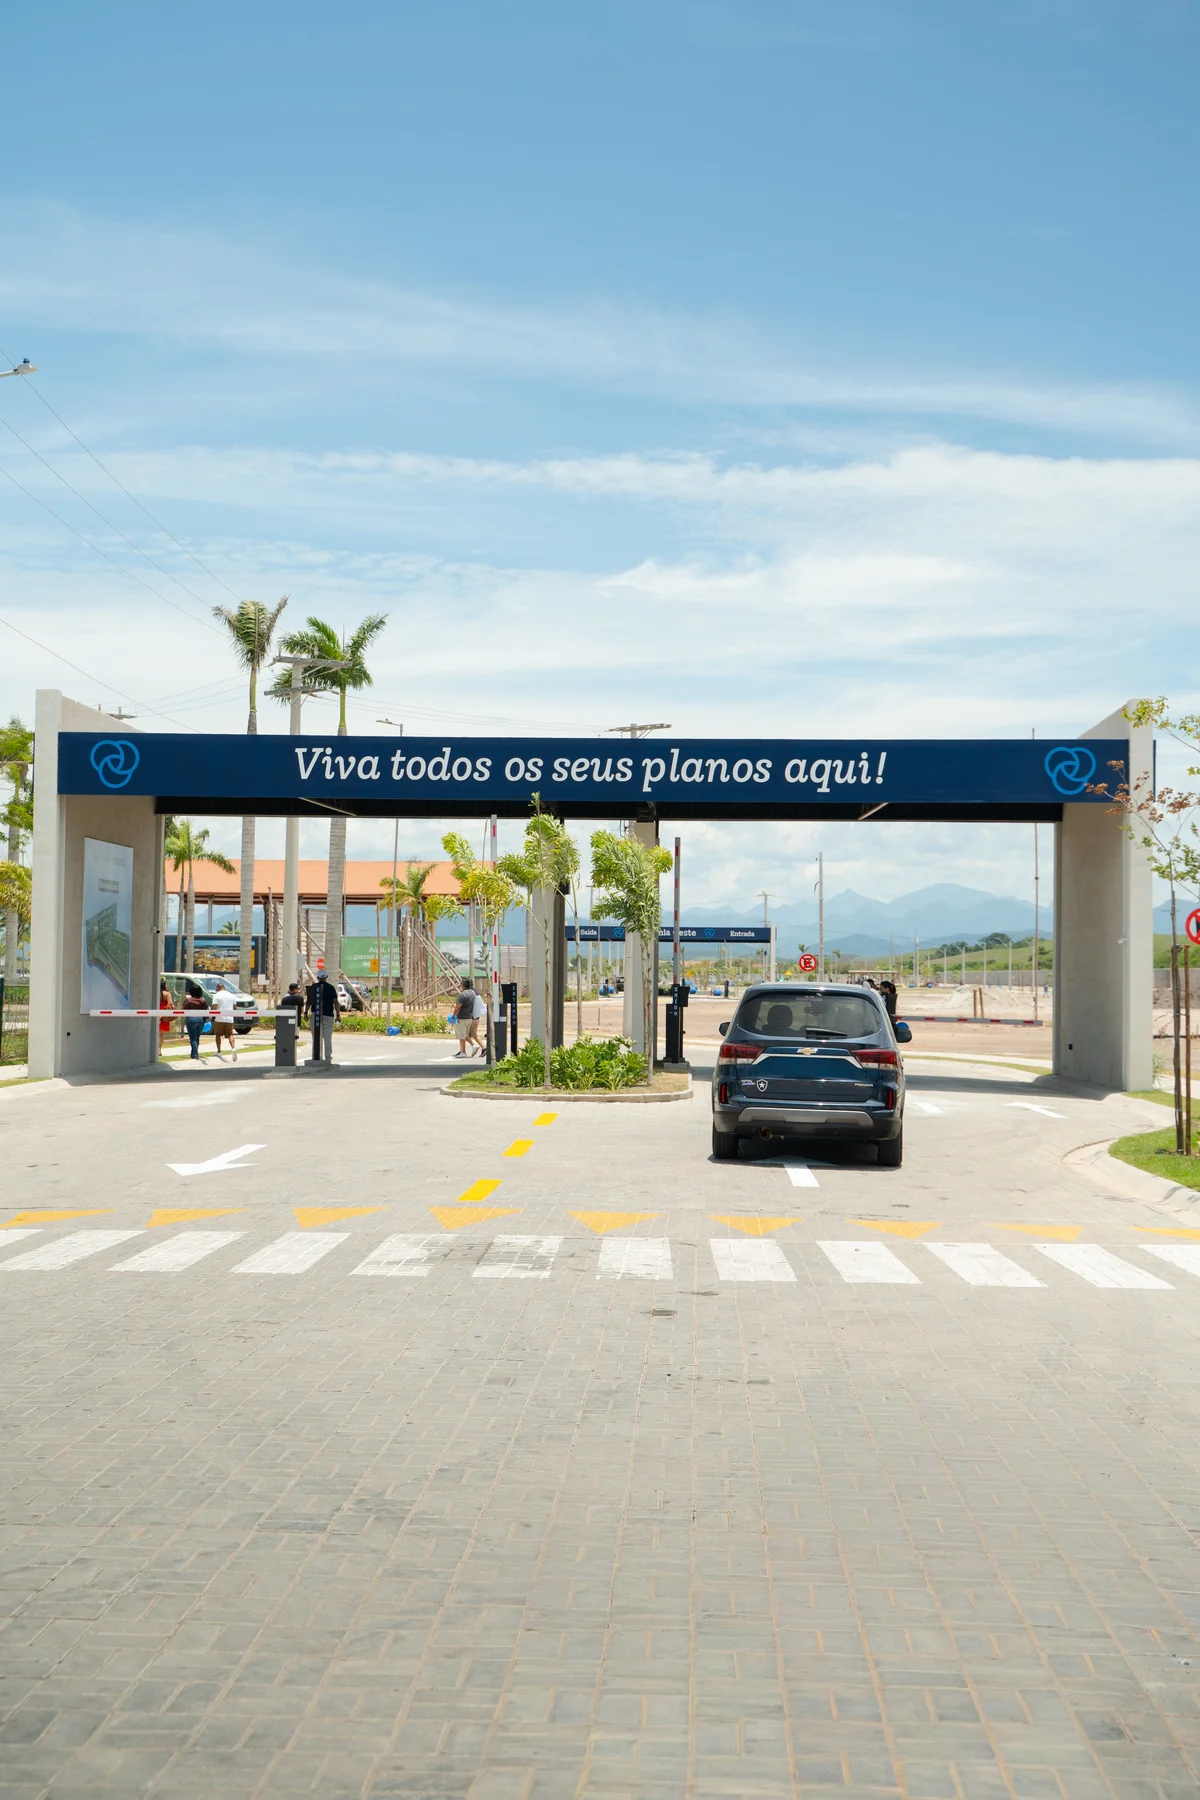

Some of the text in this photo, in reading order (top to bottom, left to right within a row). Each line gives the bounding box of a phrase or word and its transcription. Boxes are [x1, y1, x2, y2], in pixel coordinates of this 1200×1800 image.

[295, 747, 887, 793] Viva todos os seus planos aqui!
[672, 929, 697, 937] este
